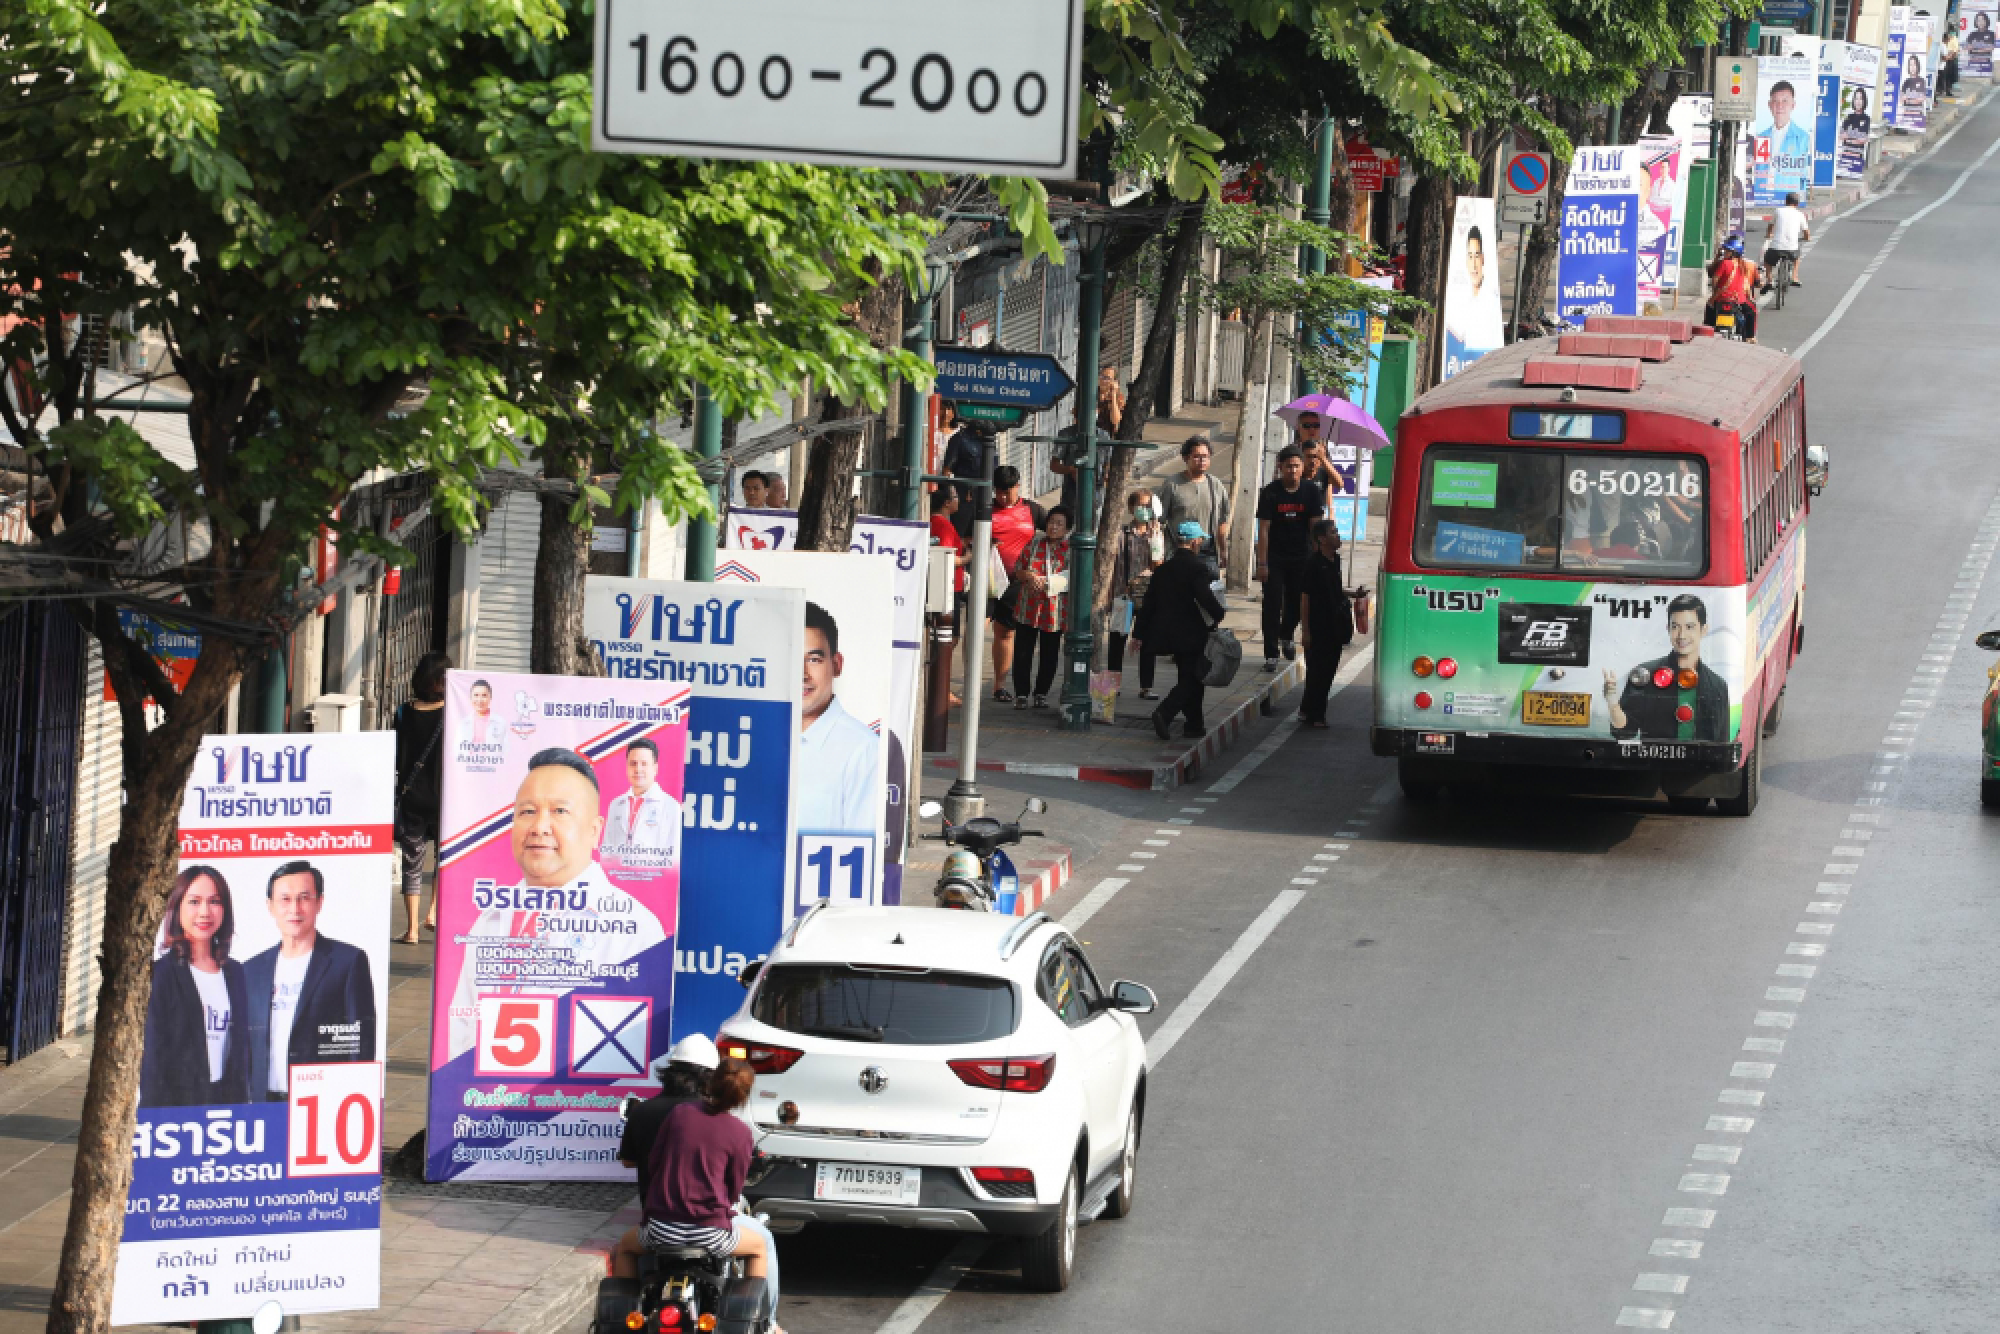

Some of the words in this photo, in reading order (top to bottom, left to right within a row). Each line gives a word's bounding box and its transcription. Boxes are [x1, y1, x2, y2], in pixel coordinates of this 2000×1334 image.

[1565, 201, 1627, 227] คิดใหม่
[1563, 274, 1616, 299] พลิกฟื้น
[1568, 469, 1701, 499] 6-50216
[607, 642, 643, 653] พรรค
[543, 698, 681, 724] พรรคชาติไทยพัฒนา
[1621, 744, 1688, 761] 6-50216
[193, 786, 333, 819] ไทยรักษาชาติ
[181, 833, 243, 853] ก้าวไกล
[807, 845, 866, 899] 11
[474, 879, 591, 911] จิรเสกข์
[597, 892, 633, 914] (นิ่ม)
[536, 912, 637, 935] วัฒนมงคล
[599, 961, 639, 982] ธนบุรี
[492, 1003, 541, 1067] 5
[132, 1109, 265, 1159] สราริน
[294, 1092, 376, 1167] 10
[172, 1157, 283, 1185] ชาลีวรรณ
[866, 1169, 903, 1187] 5939
[125, 1197, 151, 1214] ขต
[157, 1193, 181, 1212] 22
[185, 1195, 249, 1211] คลองสาน
[255, 1187, 339, 1208] บางกอกใหญ่
[343, 1185, 381, 1204] ธนบุรี
[156, 1247, 218, 1268] คิดใหม่
[235, 1243, 292, 1264] ทำใหม่
[162, 1273, 210, 1298] กล้า
[233, 1270, 346, 1295] เปลี่ยนแปลง
